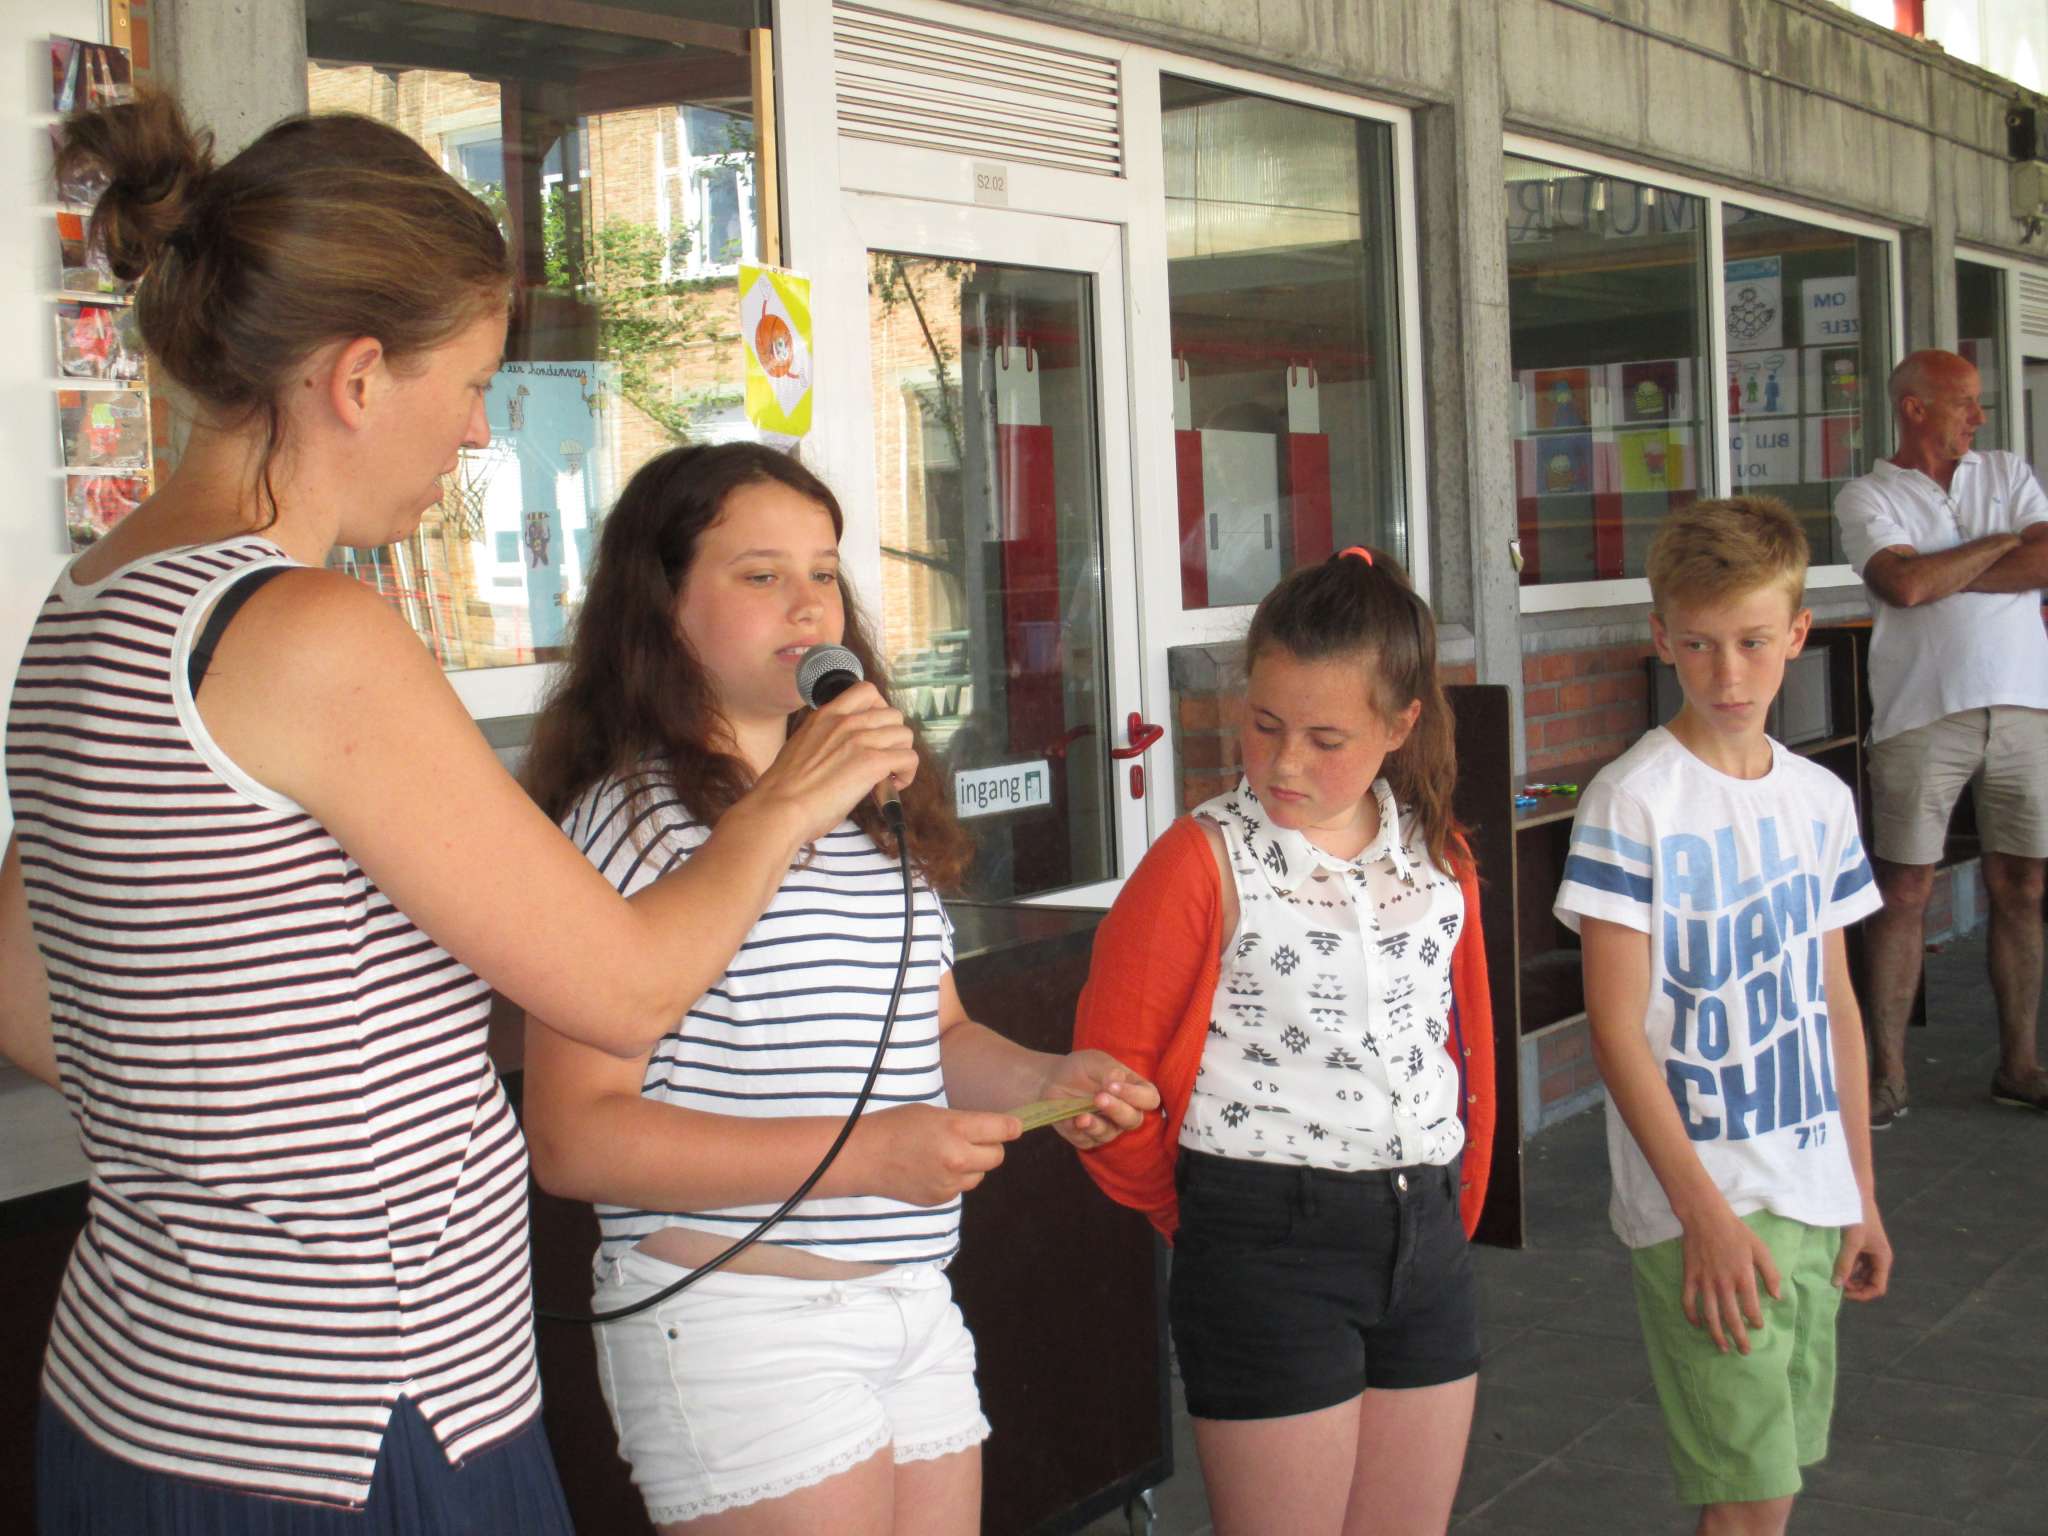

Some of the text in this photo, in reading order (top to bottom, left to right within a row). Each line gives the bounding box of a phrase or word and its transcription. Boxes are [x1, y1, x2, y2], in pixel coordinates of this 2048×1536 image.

[961, 776, 1021, 808] ingang
[1660, 816, 1799, 912] ALL
[1662, 977, 1730, 1062] TO
[1664, 1012, 1840, 1142] CHILL
